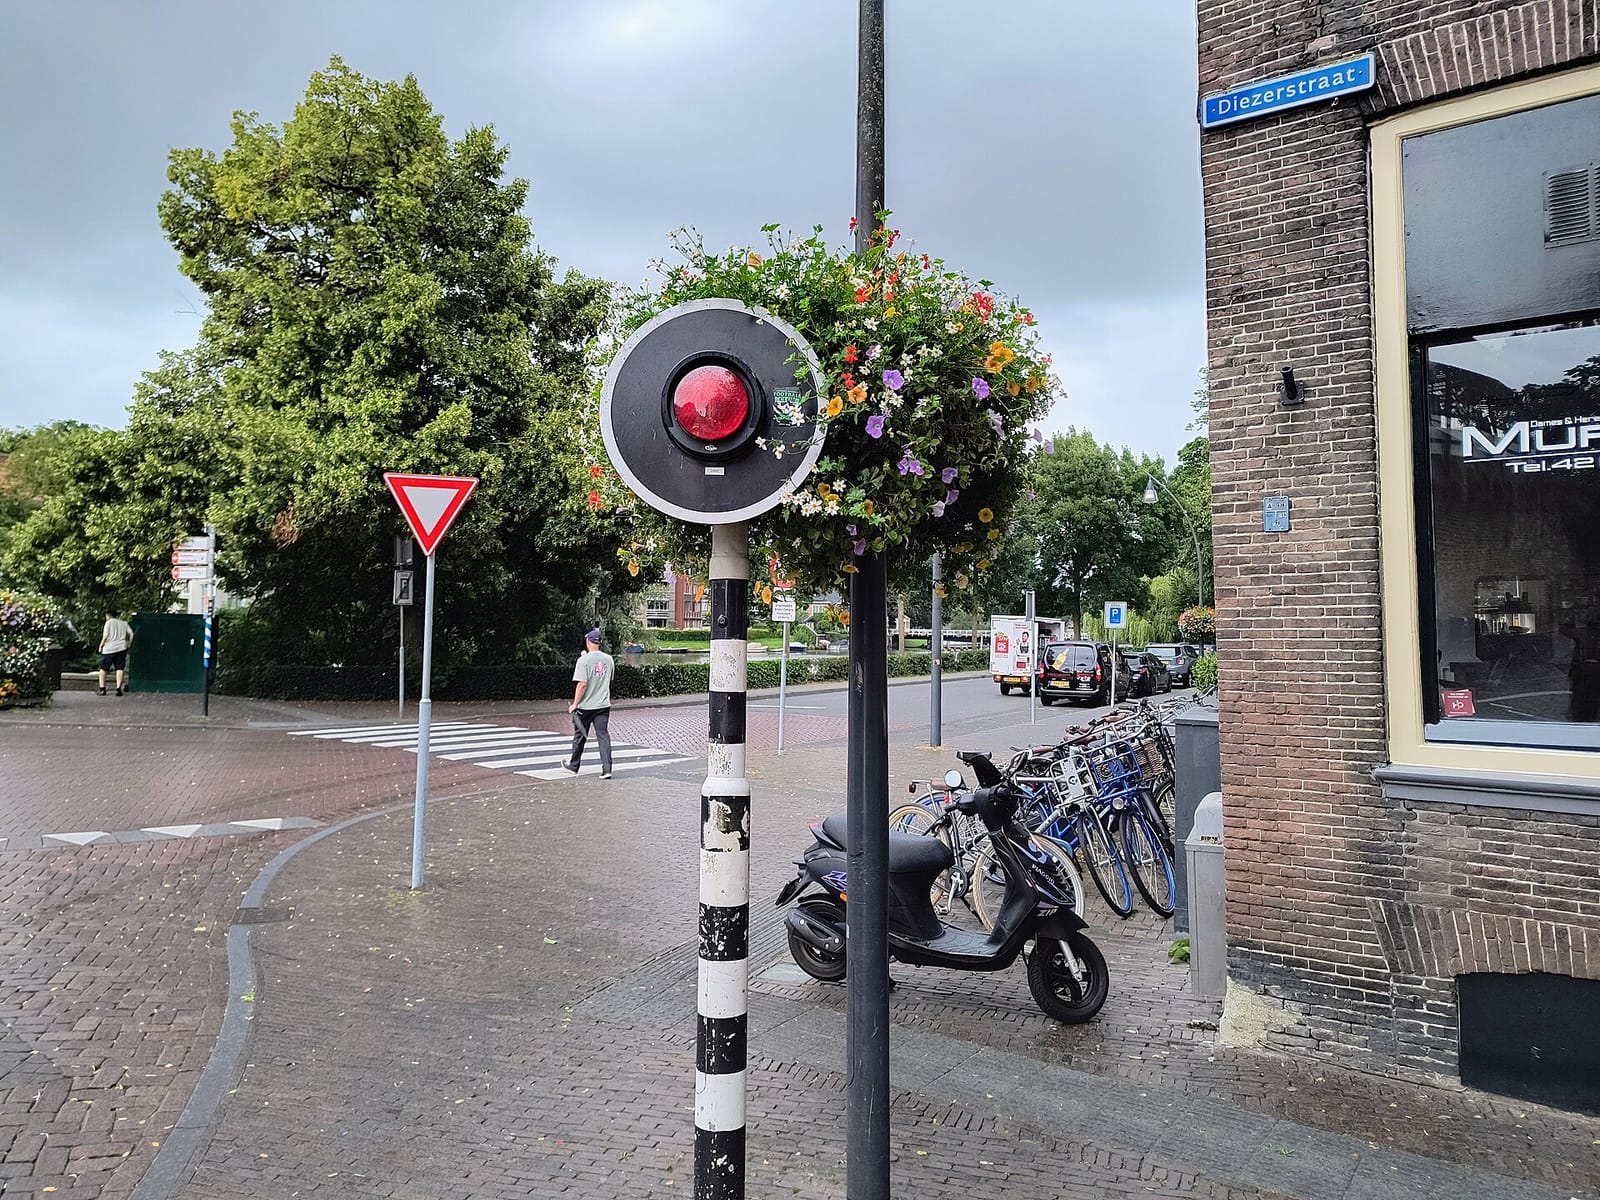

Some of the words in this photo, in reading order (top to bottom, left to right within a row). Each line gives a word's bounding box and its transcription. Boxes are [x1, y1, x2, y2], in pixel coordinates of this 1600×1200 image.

[1218, 67, 1356, 115] Diezerstraat
[1530, 419, 1563, 428] Dames
[1564, 417, 1573, 425] &
[1112, 608, 1119, 617] P
[1032, 864, 1055, 885] PIAGGIO
[1037, 908, 1057, 917] ZIP
